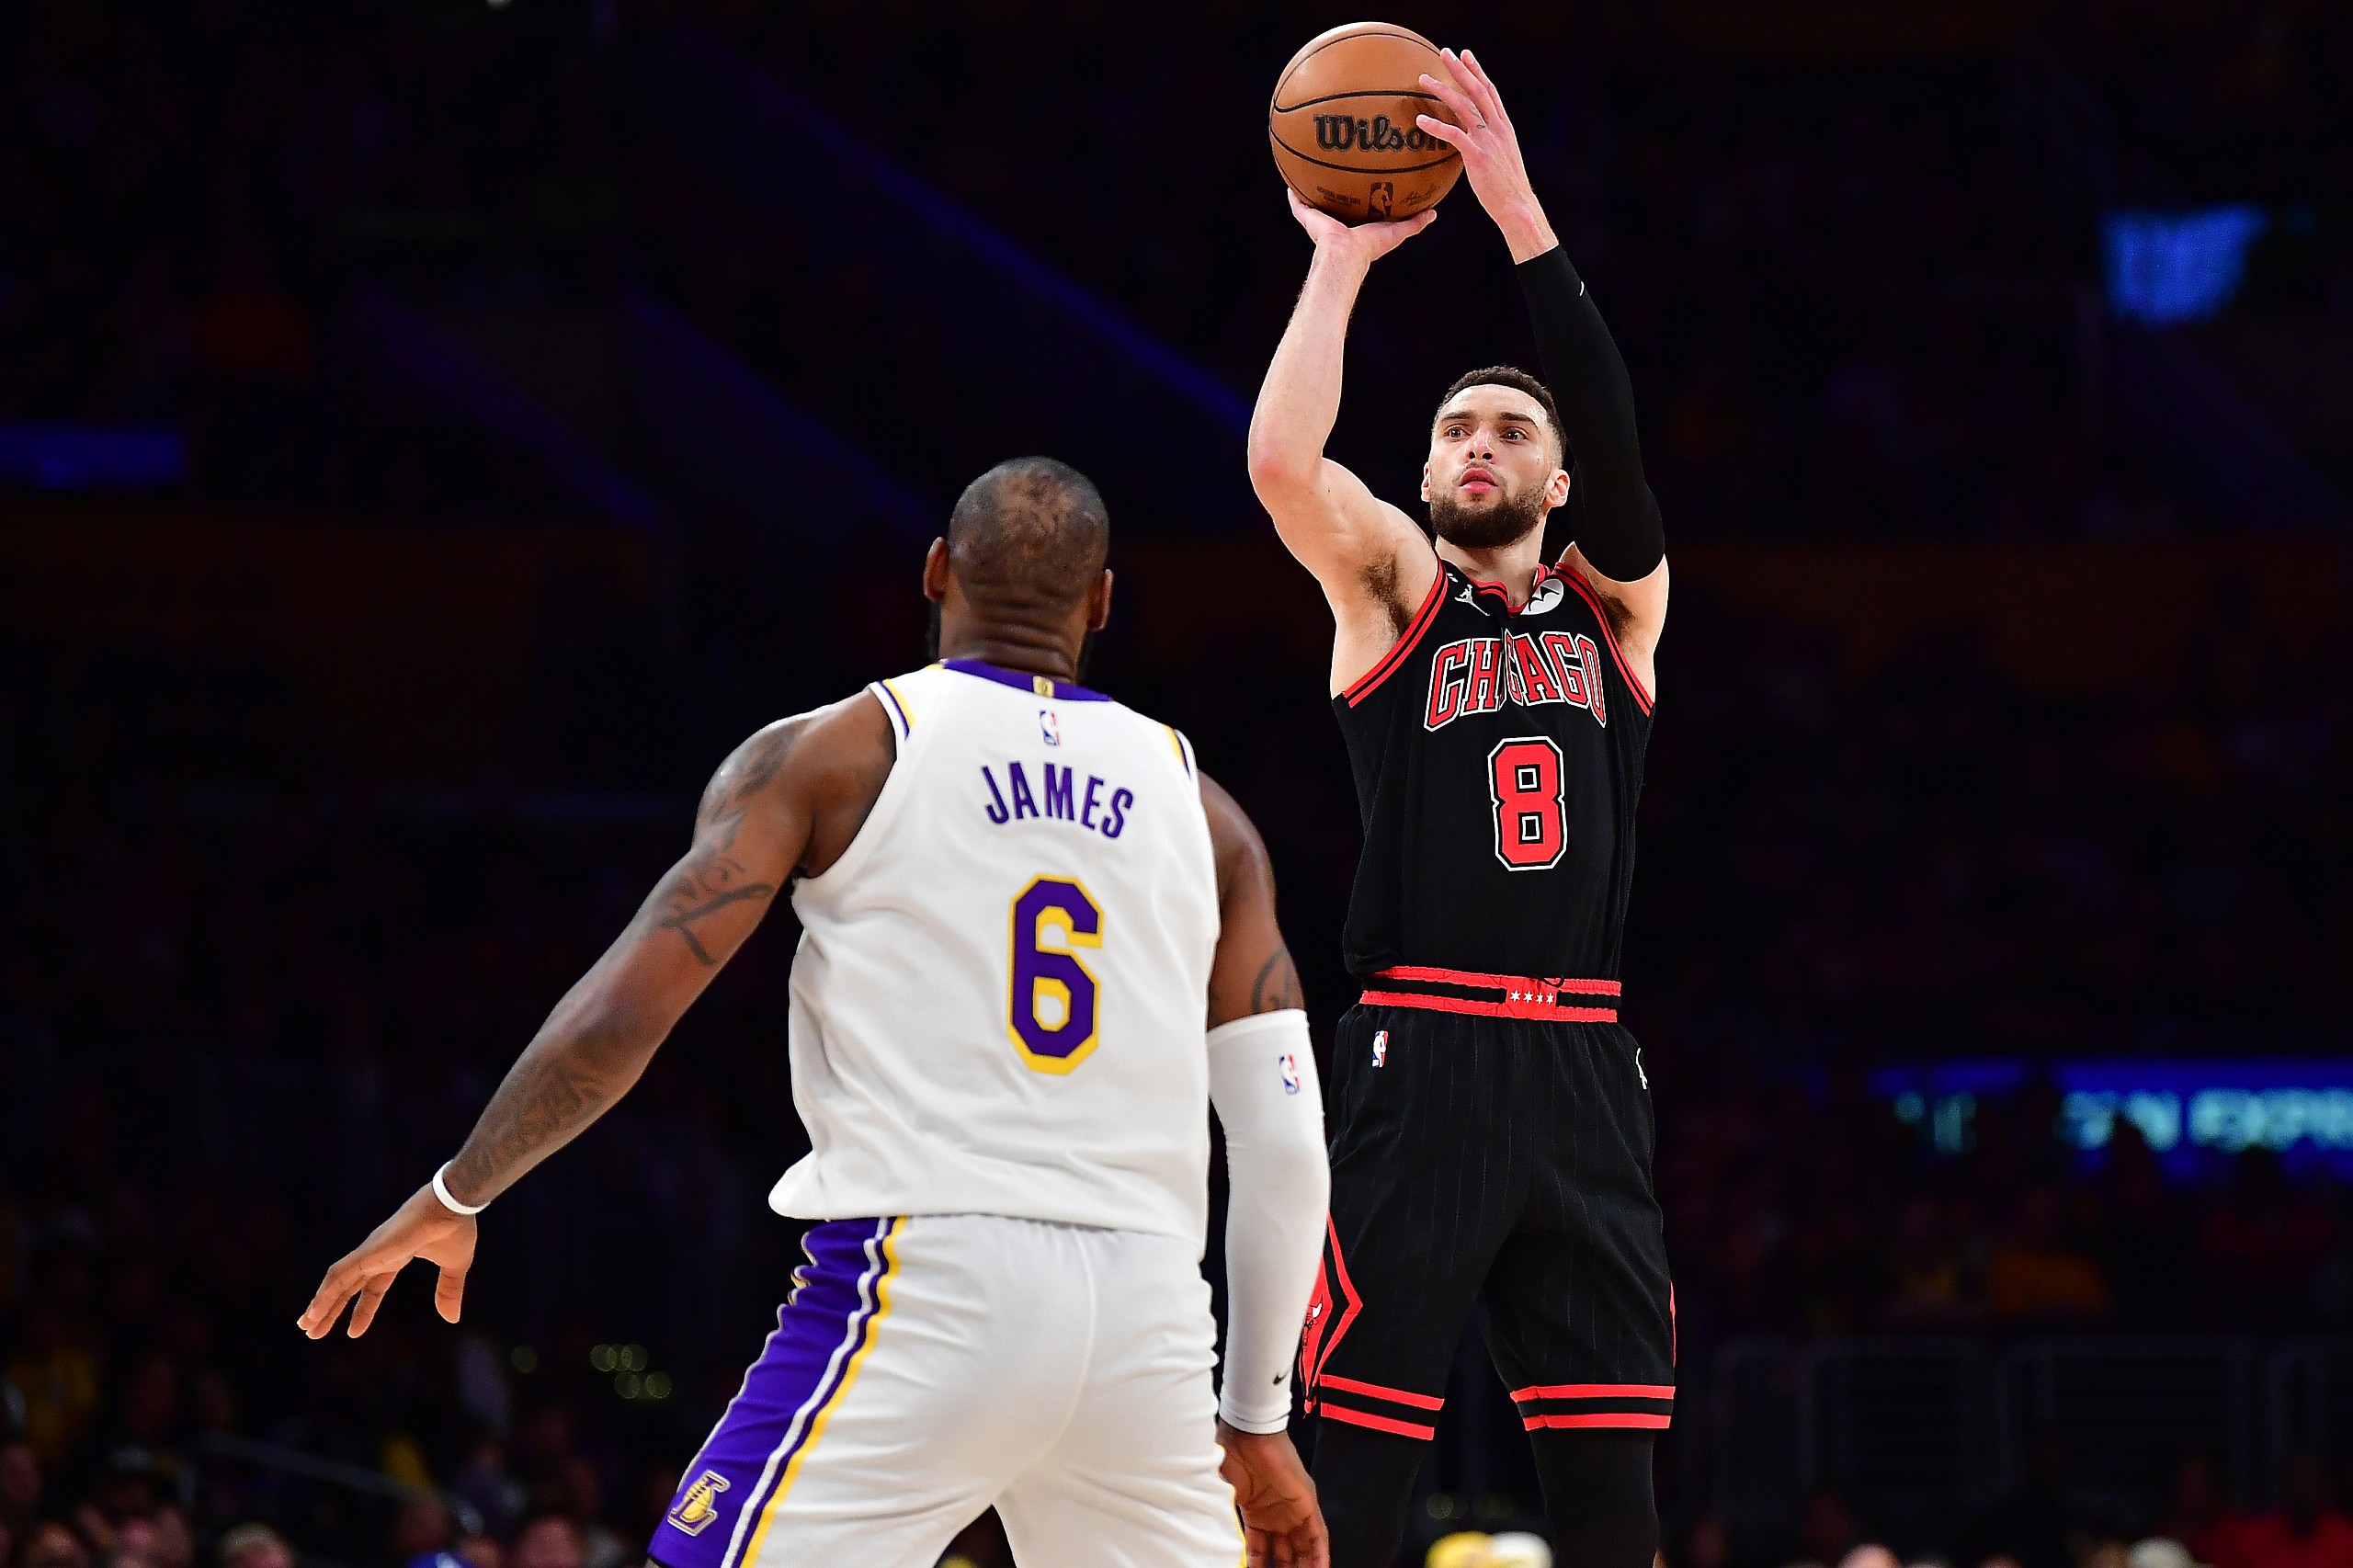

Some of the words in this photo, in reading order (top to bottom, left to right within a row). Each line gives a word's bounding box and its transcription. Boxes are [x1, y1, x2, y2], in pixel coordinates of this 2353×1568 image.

[1424, 627, 1606, 732] CHCAGO
[981, 760, 1134, 840] JAMES
[1487, 736, 1567, 871] 8
[1007, 873, 1104, 1075] 6
